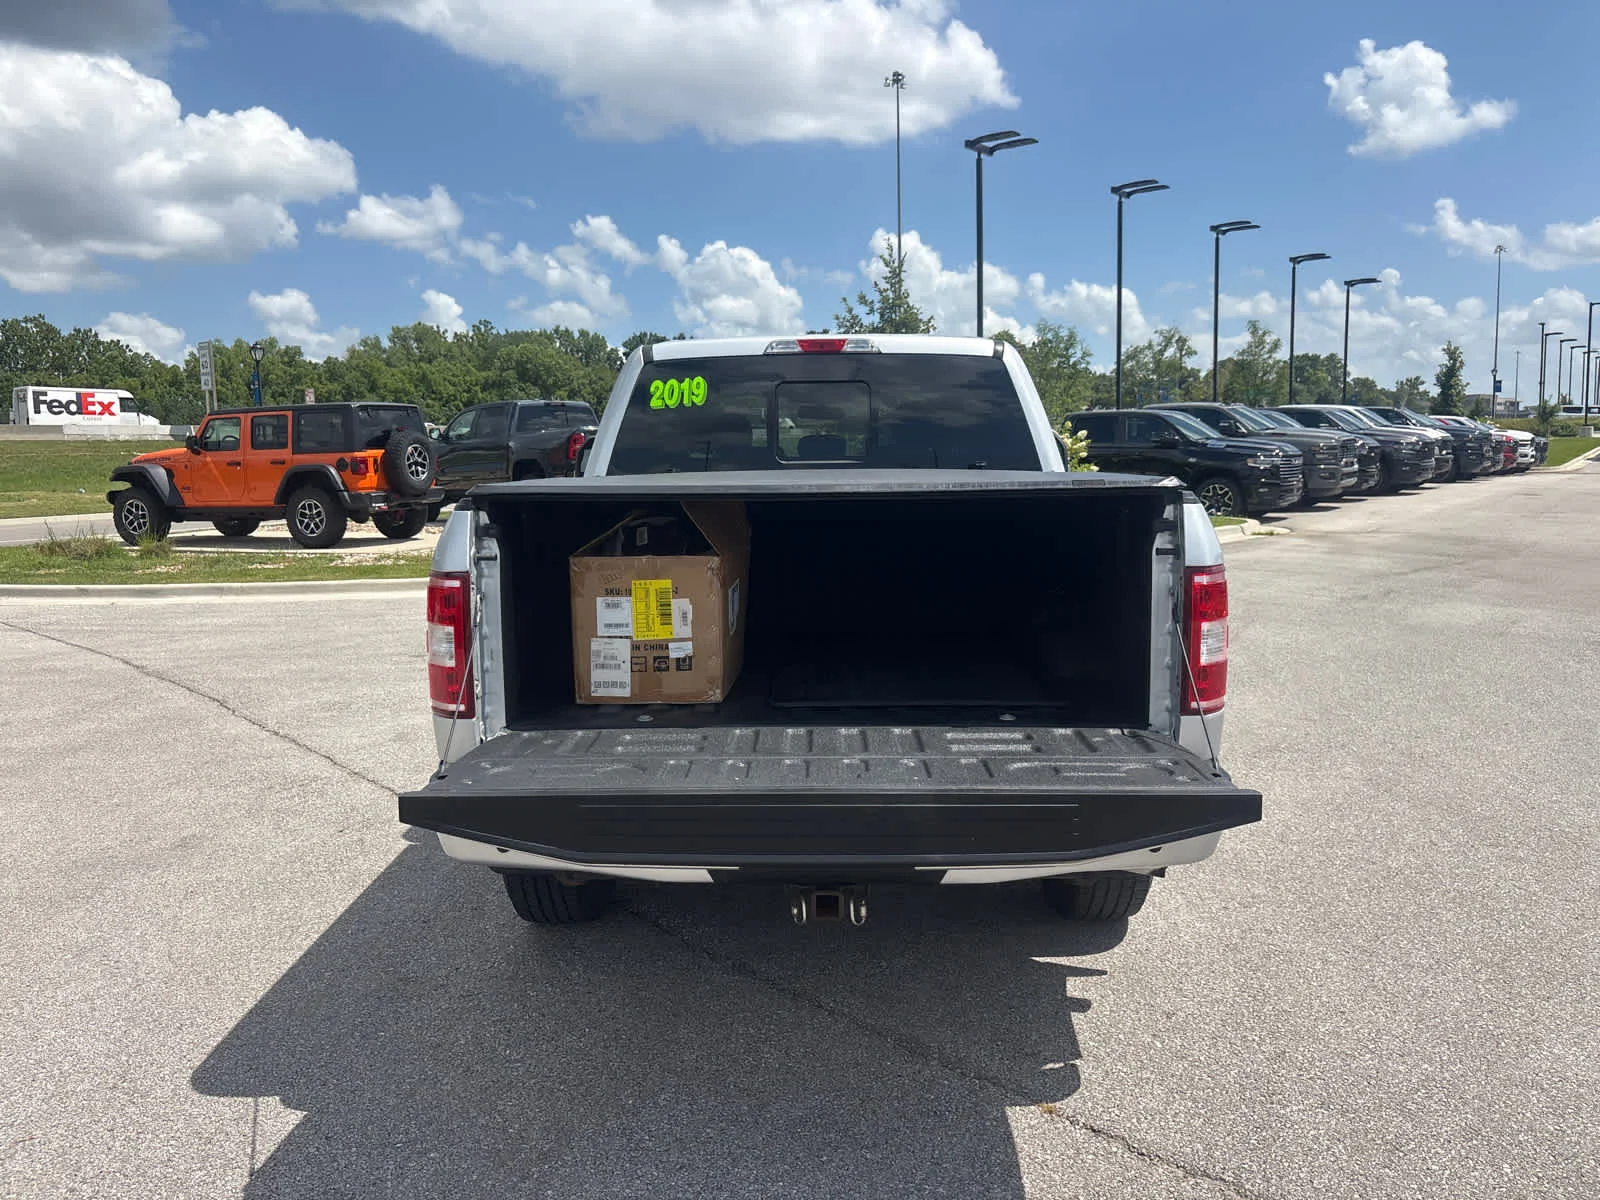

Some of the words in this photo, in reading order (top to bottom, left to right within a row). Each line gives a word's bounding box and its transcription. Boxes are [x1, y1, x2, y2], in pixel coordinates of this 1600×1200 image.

[32, 391, 117, 416] FedEx
[650, 376, 708, 410] 2019
[643, 643, 669, 651] CHINA
